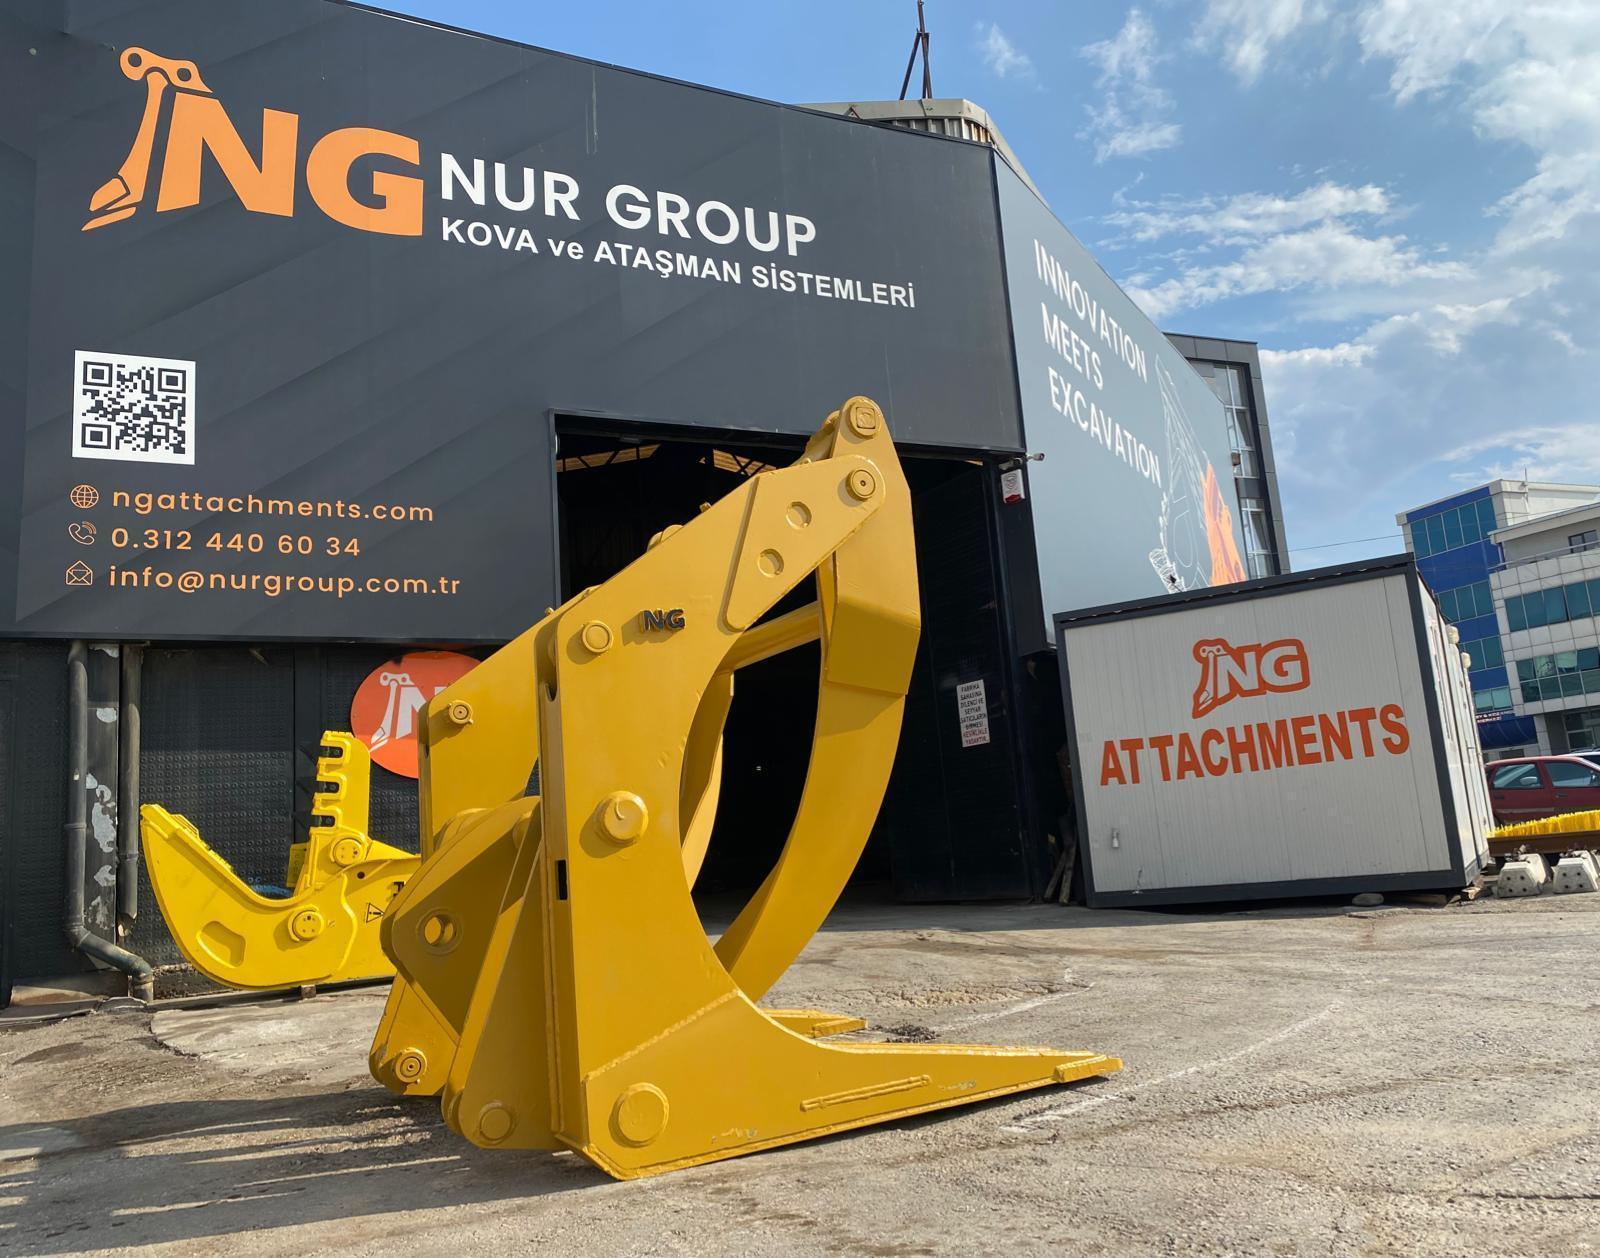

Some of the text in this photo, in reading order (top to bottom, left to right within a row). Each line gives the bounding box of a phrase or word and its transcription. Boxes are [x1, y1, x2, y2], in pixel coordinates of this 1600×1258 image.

[156, 91, 424, 237] NG
[440, 152, 817, 257] NUR GROUP
[441, 216, 915, 308] KOVA ve ATAŞMAN SİSTEMLERİ
[1034, 239, 1147, 383] INNOVATION
[1041, 301, 1104, 390] MEETS
[1047, 365, 1162, 488] EXCAVATION
[111, 527, 360, 557] 0.312 440 60 34
[112, 488, 433, 521] ngattachments.com
[109, 565, 460, 598] info@nurgroup.com.tr
[643, 608, 685, 630] NG
[1213, 640, 1310, 701] NG
[1100, 703, 1410, 786] ATTACHMENTS
